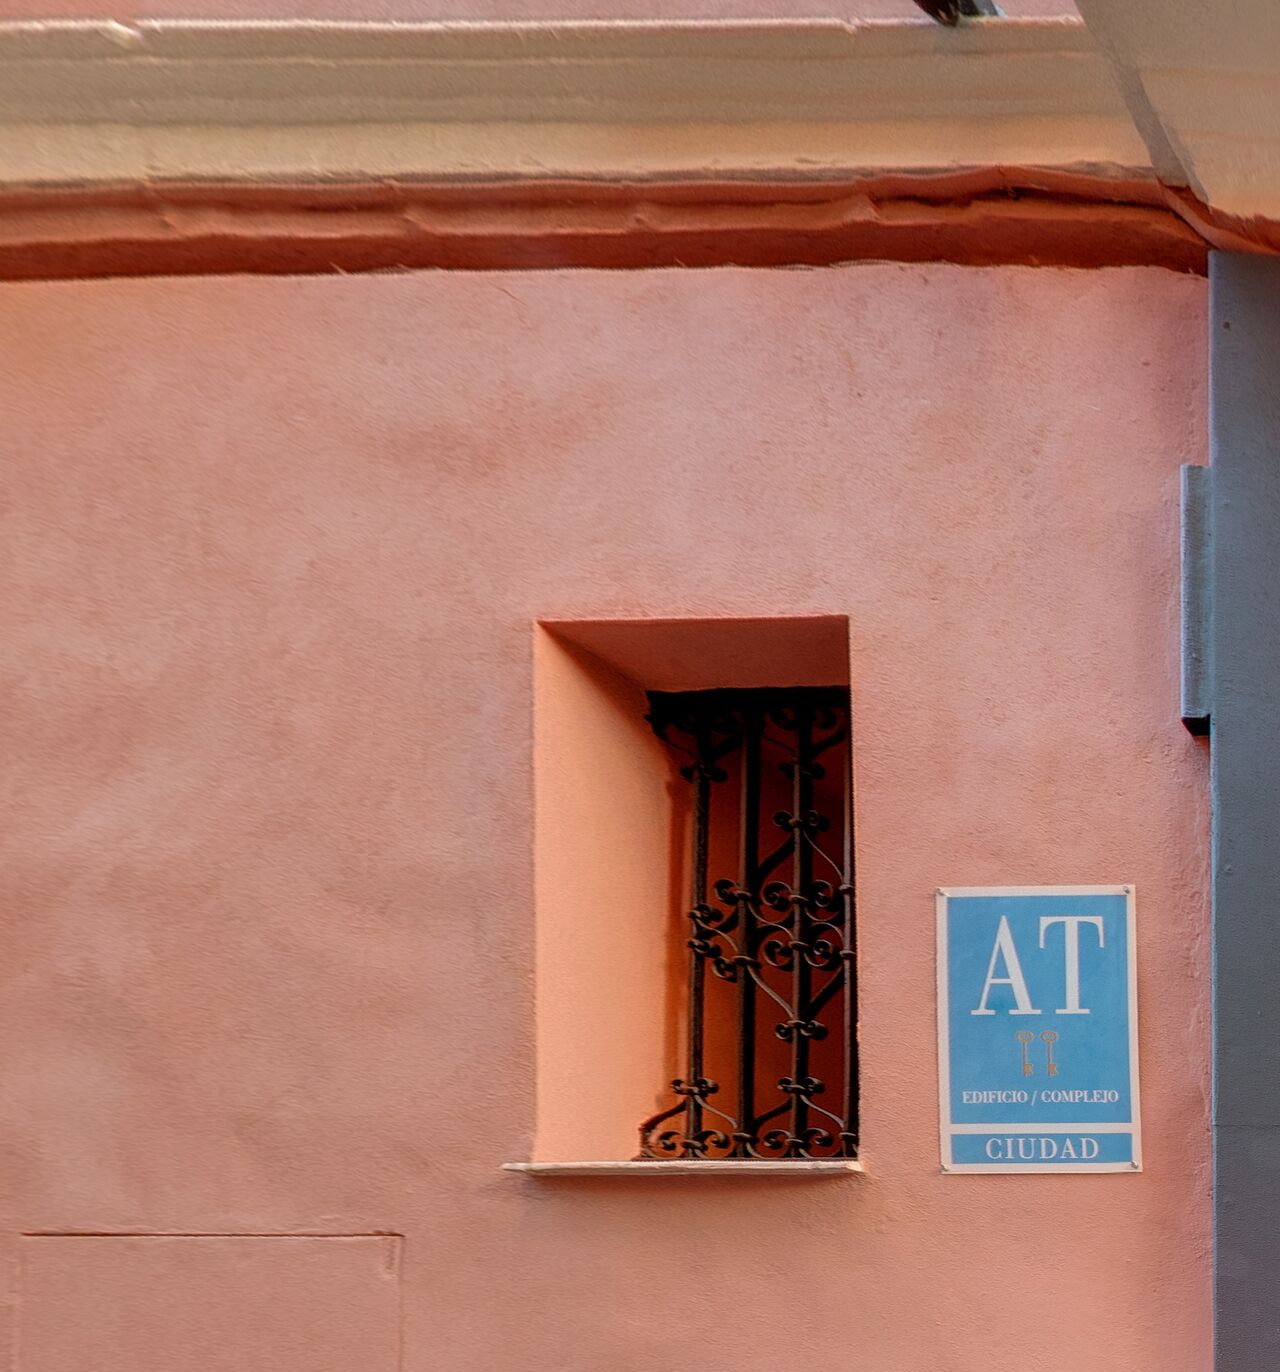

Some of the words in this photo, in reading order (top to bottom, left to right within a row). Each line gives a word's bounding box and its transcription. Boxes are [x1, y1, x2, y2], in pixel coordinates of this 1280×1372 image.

[970, 915, 1105, 1015] AT
[962, 1090, 1028, 1104] EDIFICIO
[1040, 1089, 1119, 1104] COMPLEJO
[985, 1137, 1099, 1160] CIUDAD
